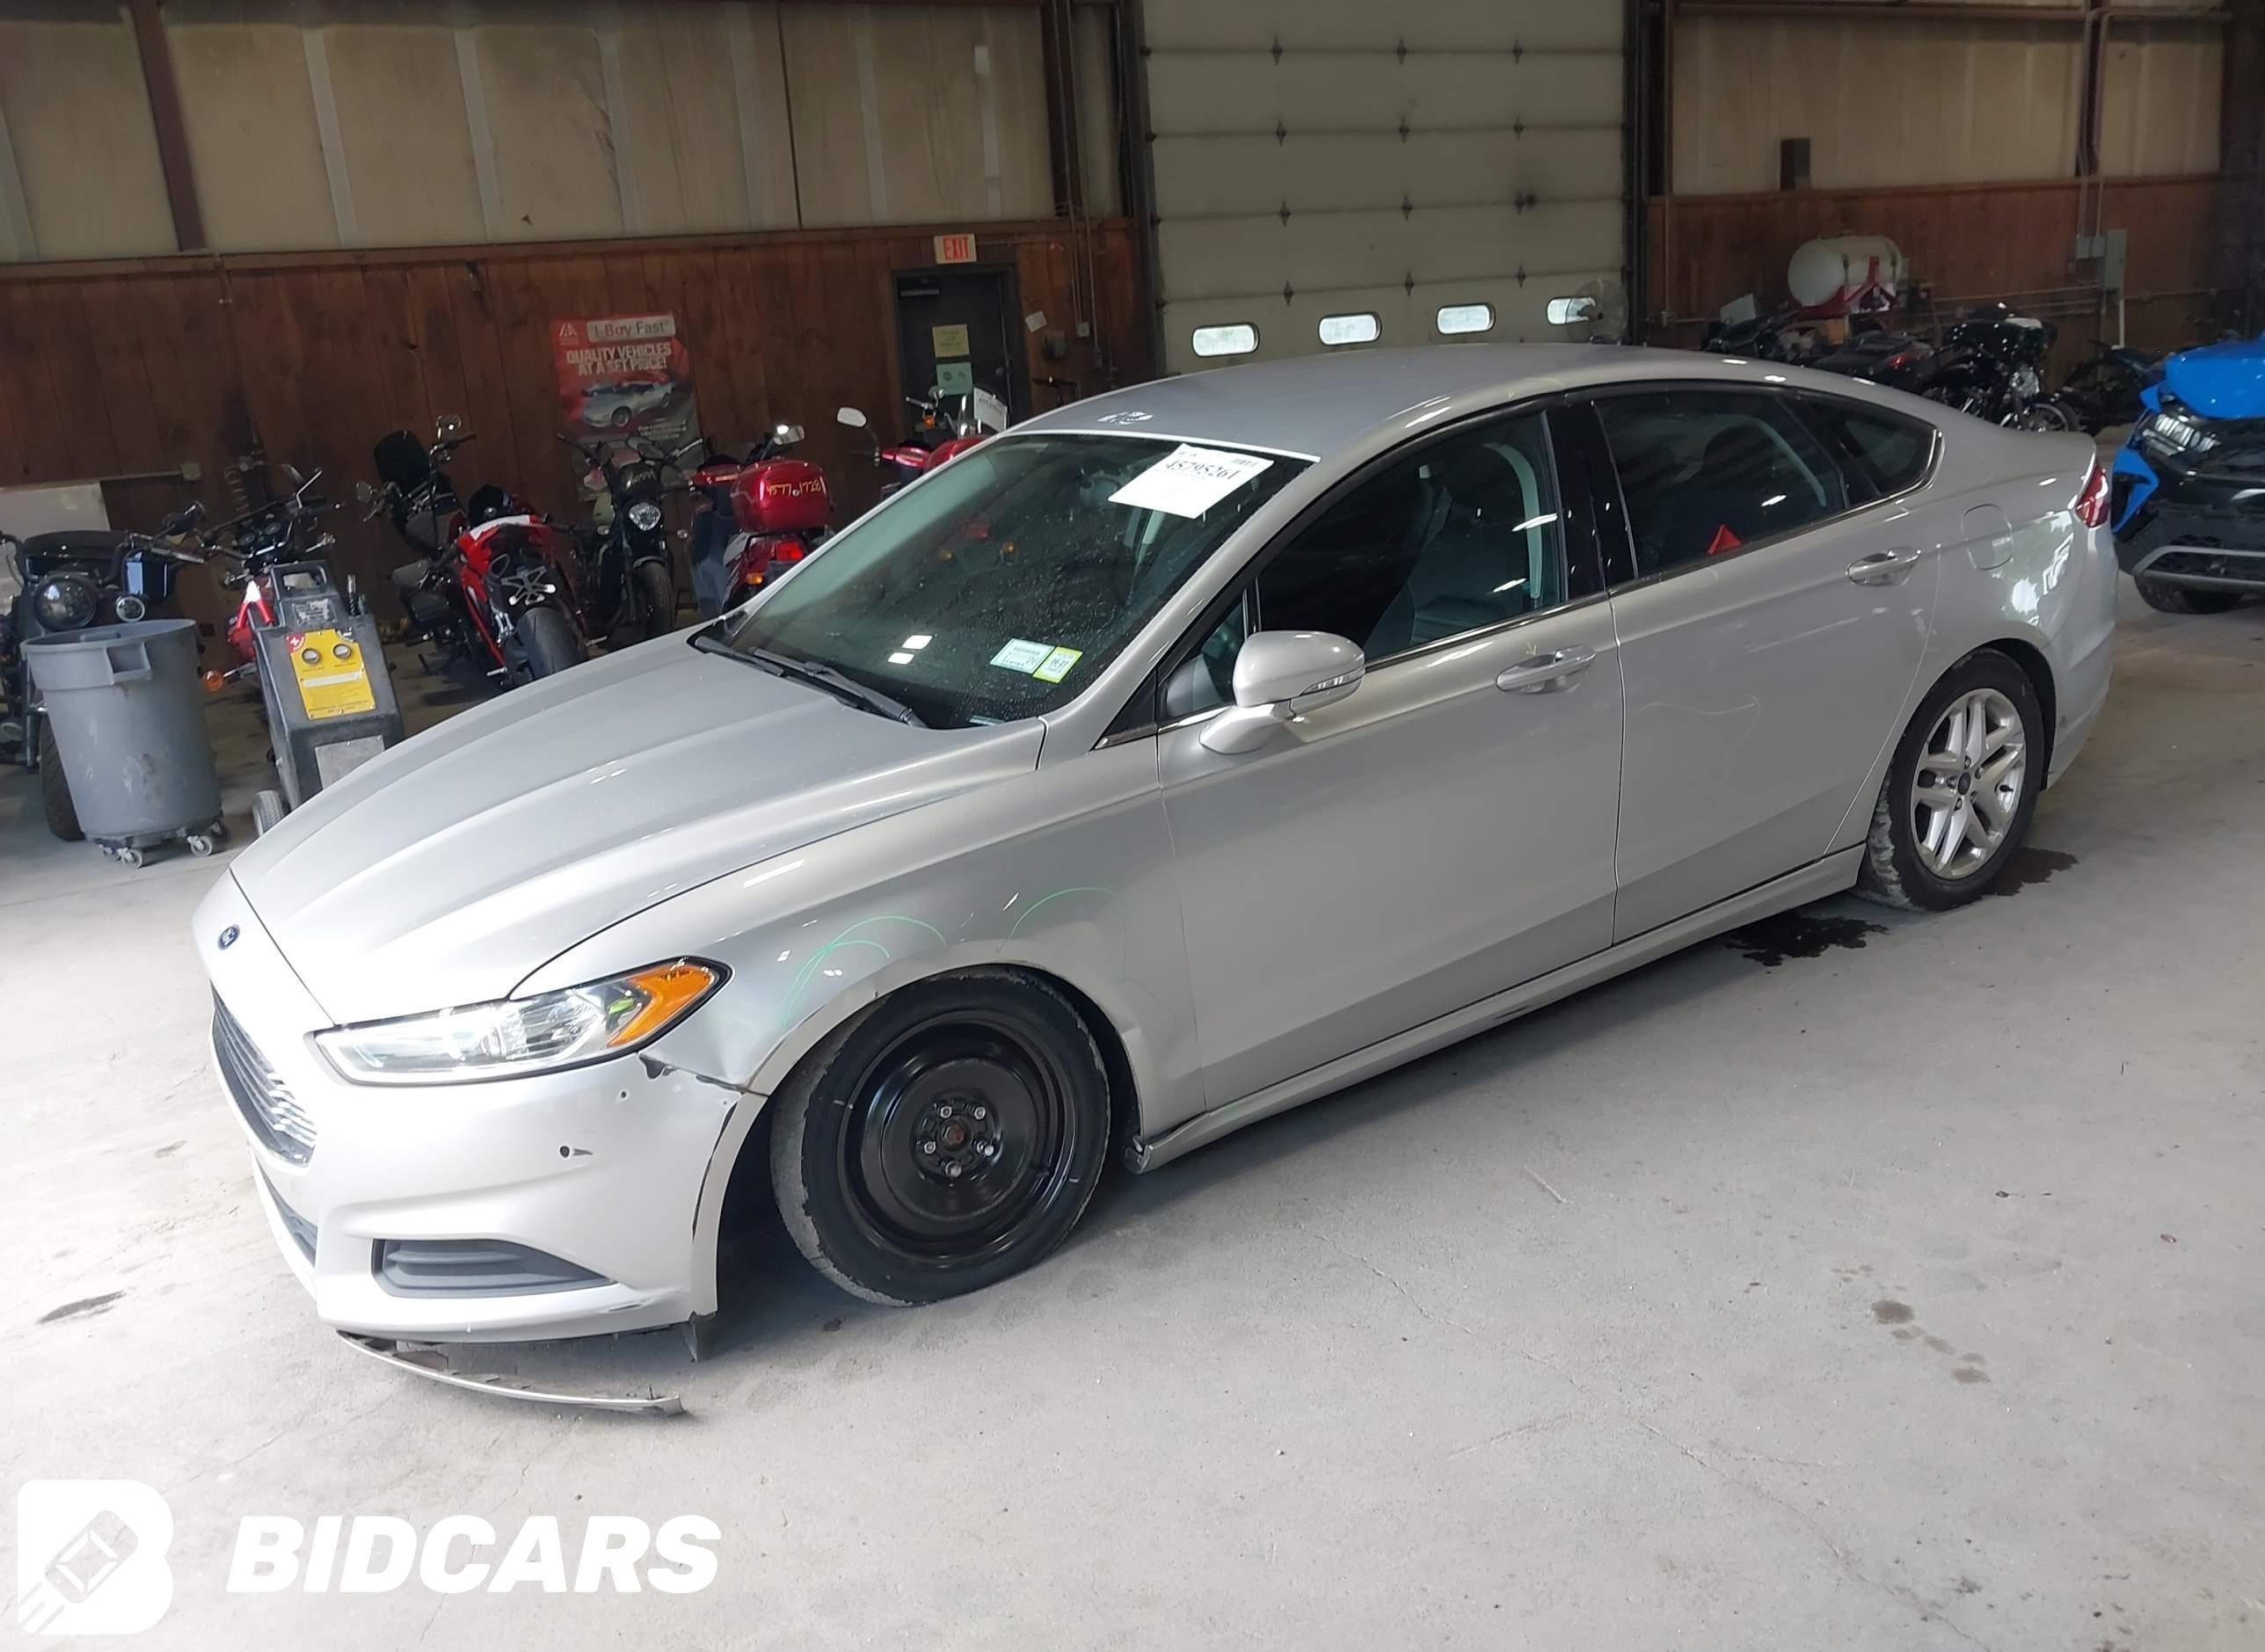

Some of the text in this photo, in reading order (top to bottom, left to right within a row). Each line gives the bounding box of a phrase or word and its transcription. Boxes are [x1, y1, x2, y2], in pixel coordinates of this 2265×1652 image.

[943, 236, 970, 261] EXIT
[594, 321, 664, 338] I-Buy Fast
[566, 342, 672, 363] QUALITY VEHICLES
[579, 356, 666, 375] AT A SET PRICE!
